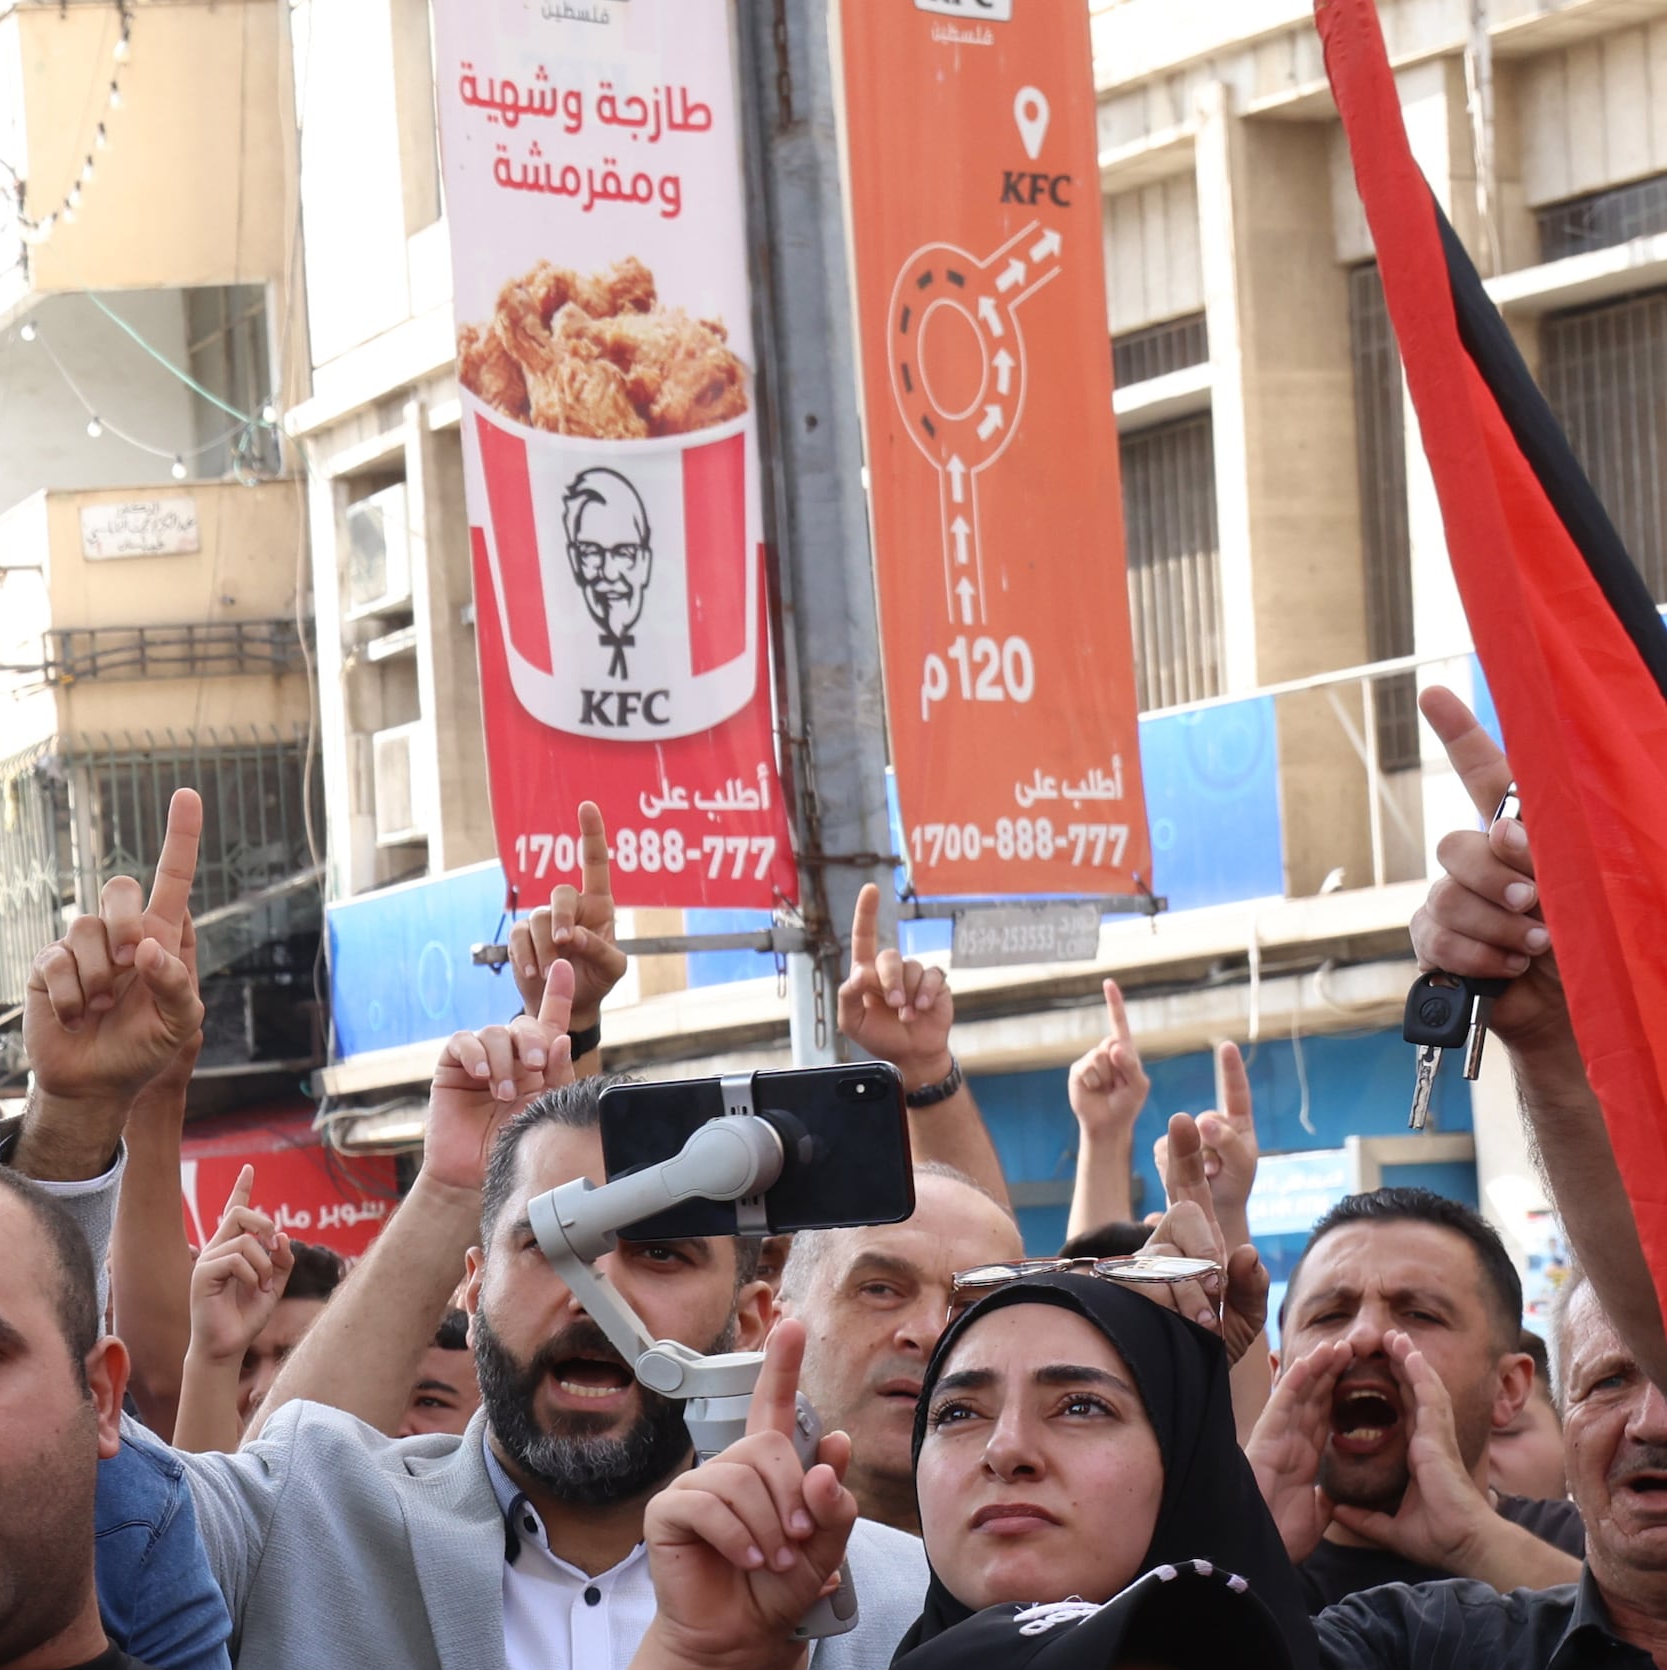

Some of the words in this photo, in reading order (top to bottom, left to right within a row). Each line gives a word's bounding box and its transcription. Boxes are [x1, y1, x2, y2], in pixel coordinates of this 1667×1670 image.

[541, 0, 610, 24] فلسطين
[931, 20, 995, 46] فلسطين
[459, 61, 583, 134] وشهية
[596, 81, 713, 143] طازجة
[493, 141, 682, 219] ومقرمشة
[999, 171, 1072, 207] KFC
[579, 689, 671, 727] KFC
[639, 777, 689, 819] على
[694, 762, 772, 822] أطلب
[1015, 768, 1058, 808] على
[1062, 754, 1123, 809] أطلب
[515, 827, 776, 881] 170-888-777
[911, 817, 1129, 867] 1700-888-777
